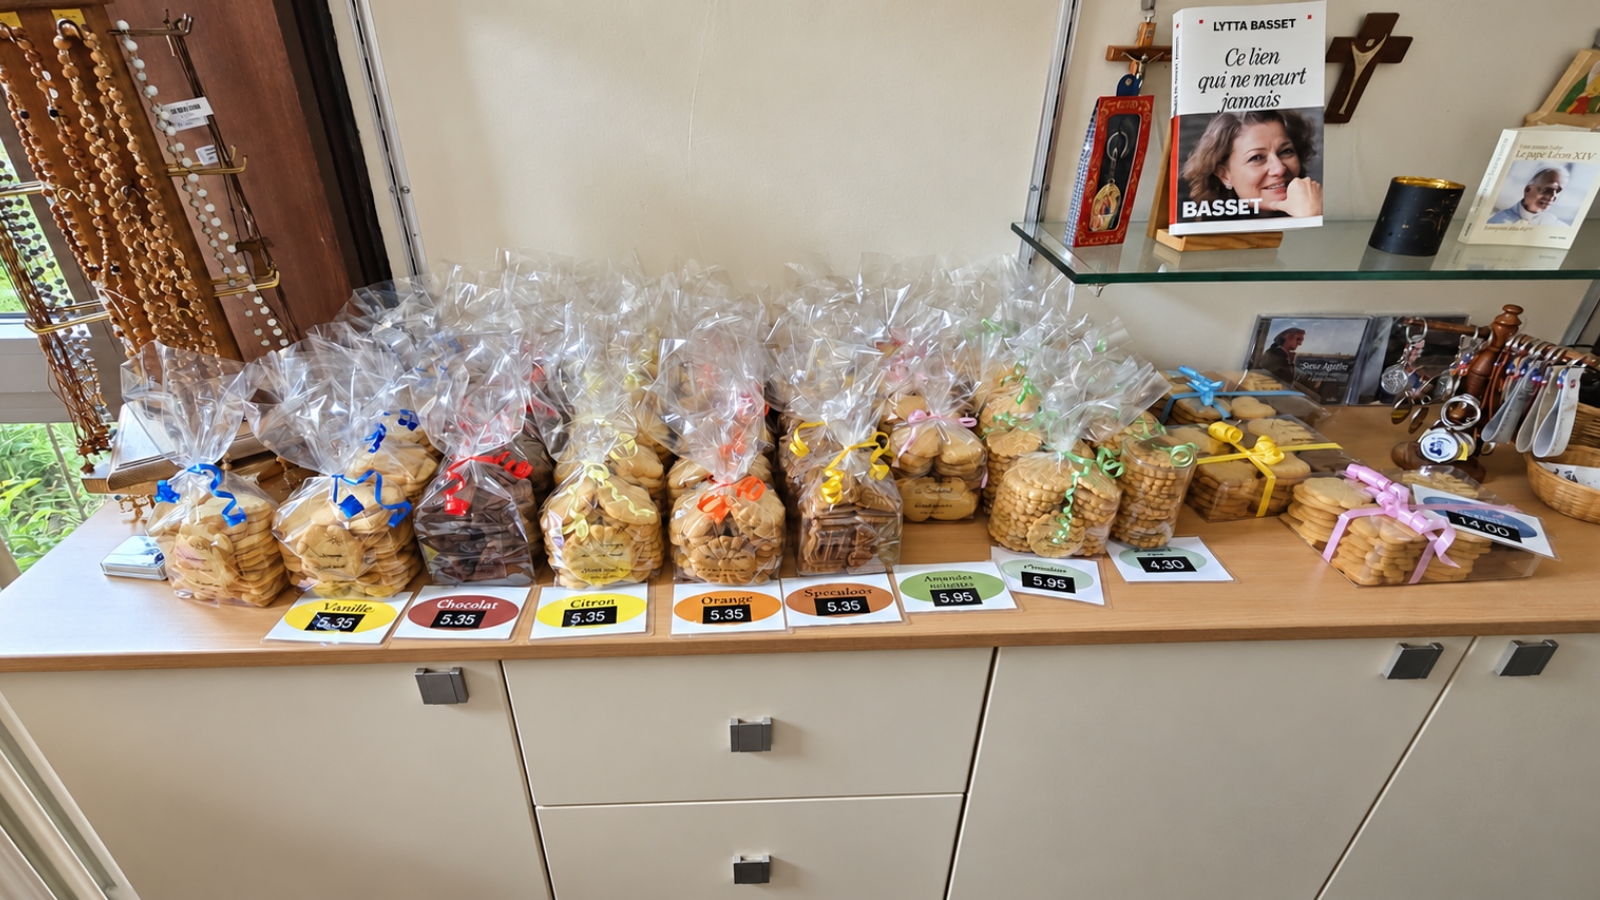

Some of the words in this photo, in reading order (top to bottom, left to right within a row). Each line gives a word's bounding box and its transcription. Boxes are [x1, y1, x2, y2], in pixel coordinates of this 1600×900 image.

[1213, 20, 1248, 32] LYTTA
[1250, 18, 1297, 31] BASSET
[1225, 47, 1246, 67] Ce
[1248, 47, 1280, 66] lien
[1198, 71, 1228, 93] qui
[1230, 75, 1251, 88] ne
[1254, 67, 1307, 86] meurt
[1218, 90, 1281, 113] jamais
[1572, 152, 1597, 160] XIV
[1182, 198, 1263, 218] BASSET
[1458, 516, 1510, 537] 14.00
[1150, 559, 1185, 570] 4.30
[924, 574, 973, 582] Amandes
[1032, 575, 1067, 589] 5.95
[570, 598, 616, 608] Citron
[701, 595, 753, 606] Orange
[939, 591, 974, 604] 5.95
[324, 602, 372, 613] Vanille
[435, 599, 498, 610] Chocolat
[827, 600, 861, 612] 5.35
[439, 614, 476, 626] 5.35
[571, 611, 606, 624] 5.35
[709, 608, 744, 621] 5.35
[316, 615, 354, 629] 5.35
